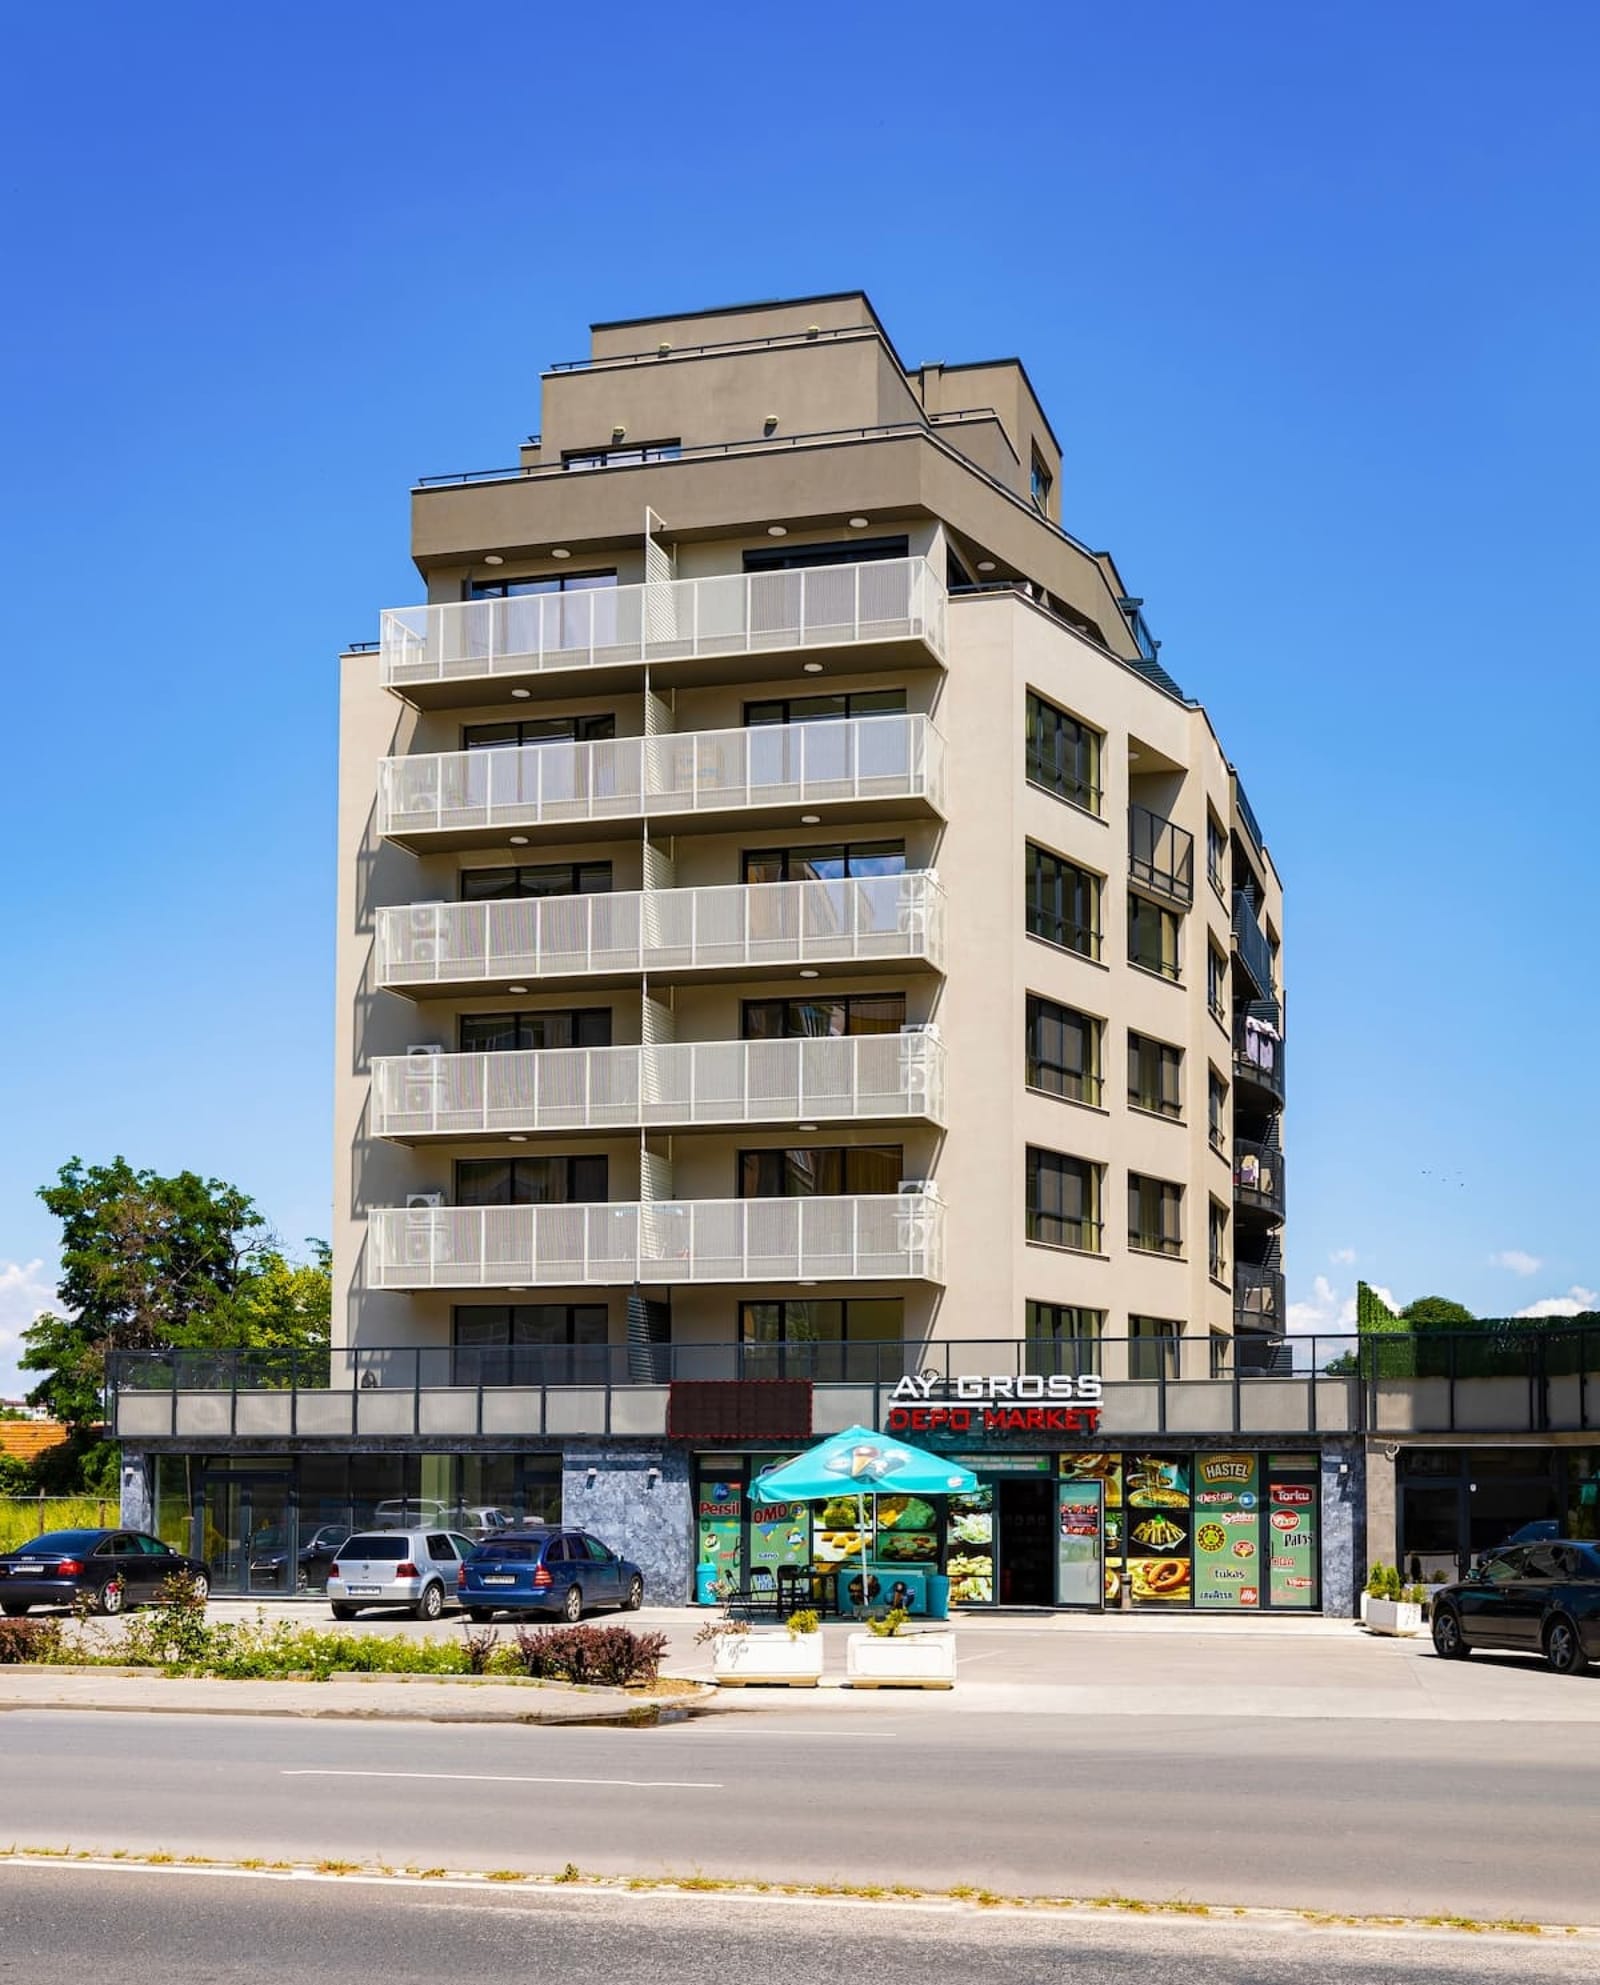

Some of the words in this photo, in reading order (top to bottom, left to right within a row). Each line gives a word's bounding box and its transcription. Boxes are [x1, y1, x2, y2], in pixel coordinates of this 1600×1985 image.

[892, 1375, 940, 1399] AY
[957, 1375, 1103, 1399] GROSS
[888, 1407, 971, 1431] DEPO
[983, 1407, 1103, 1431] MARKET
[1206, 1463, 1249, 1479] HASTEL
[1276, 1490, 1310, 1501] Torku
[699, 1501, 740, 1516] Persil
[753, 1503, 788, 1524] OMO
